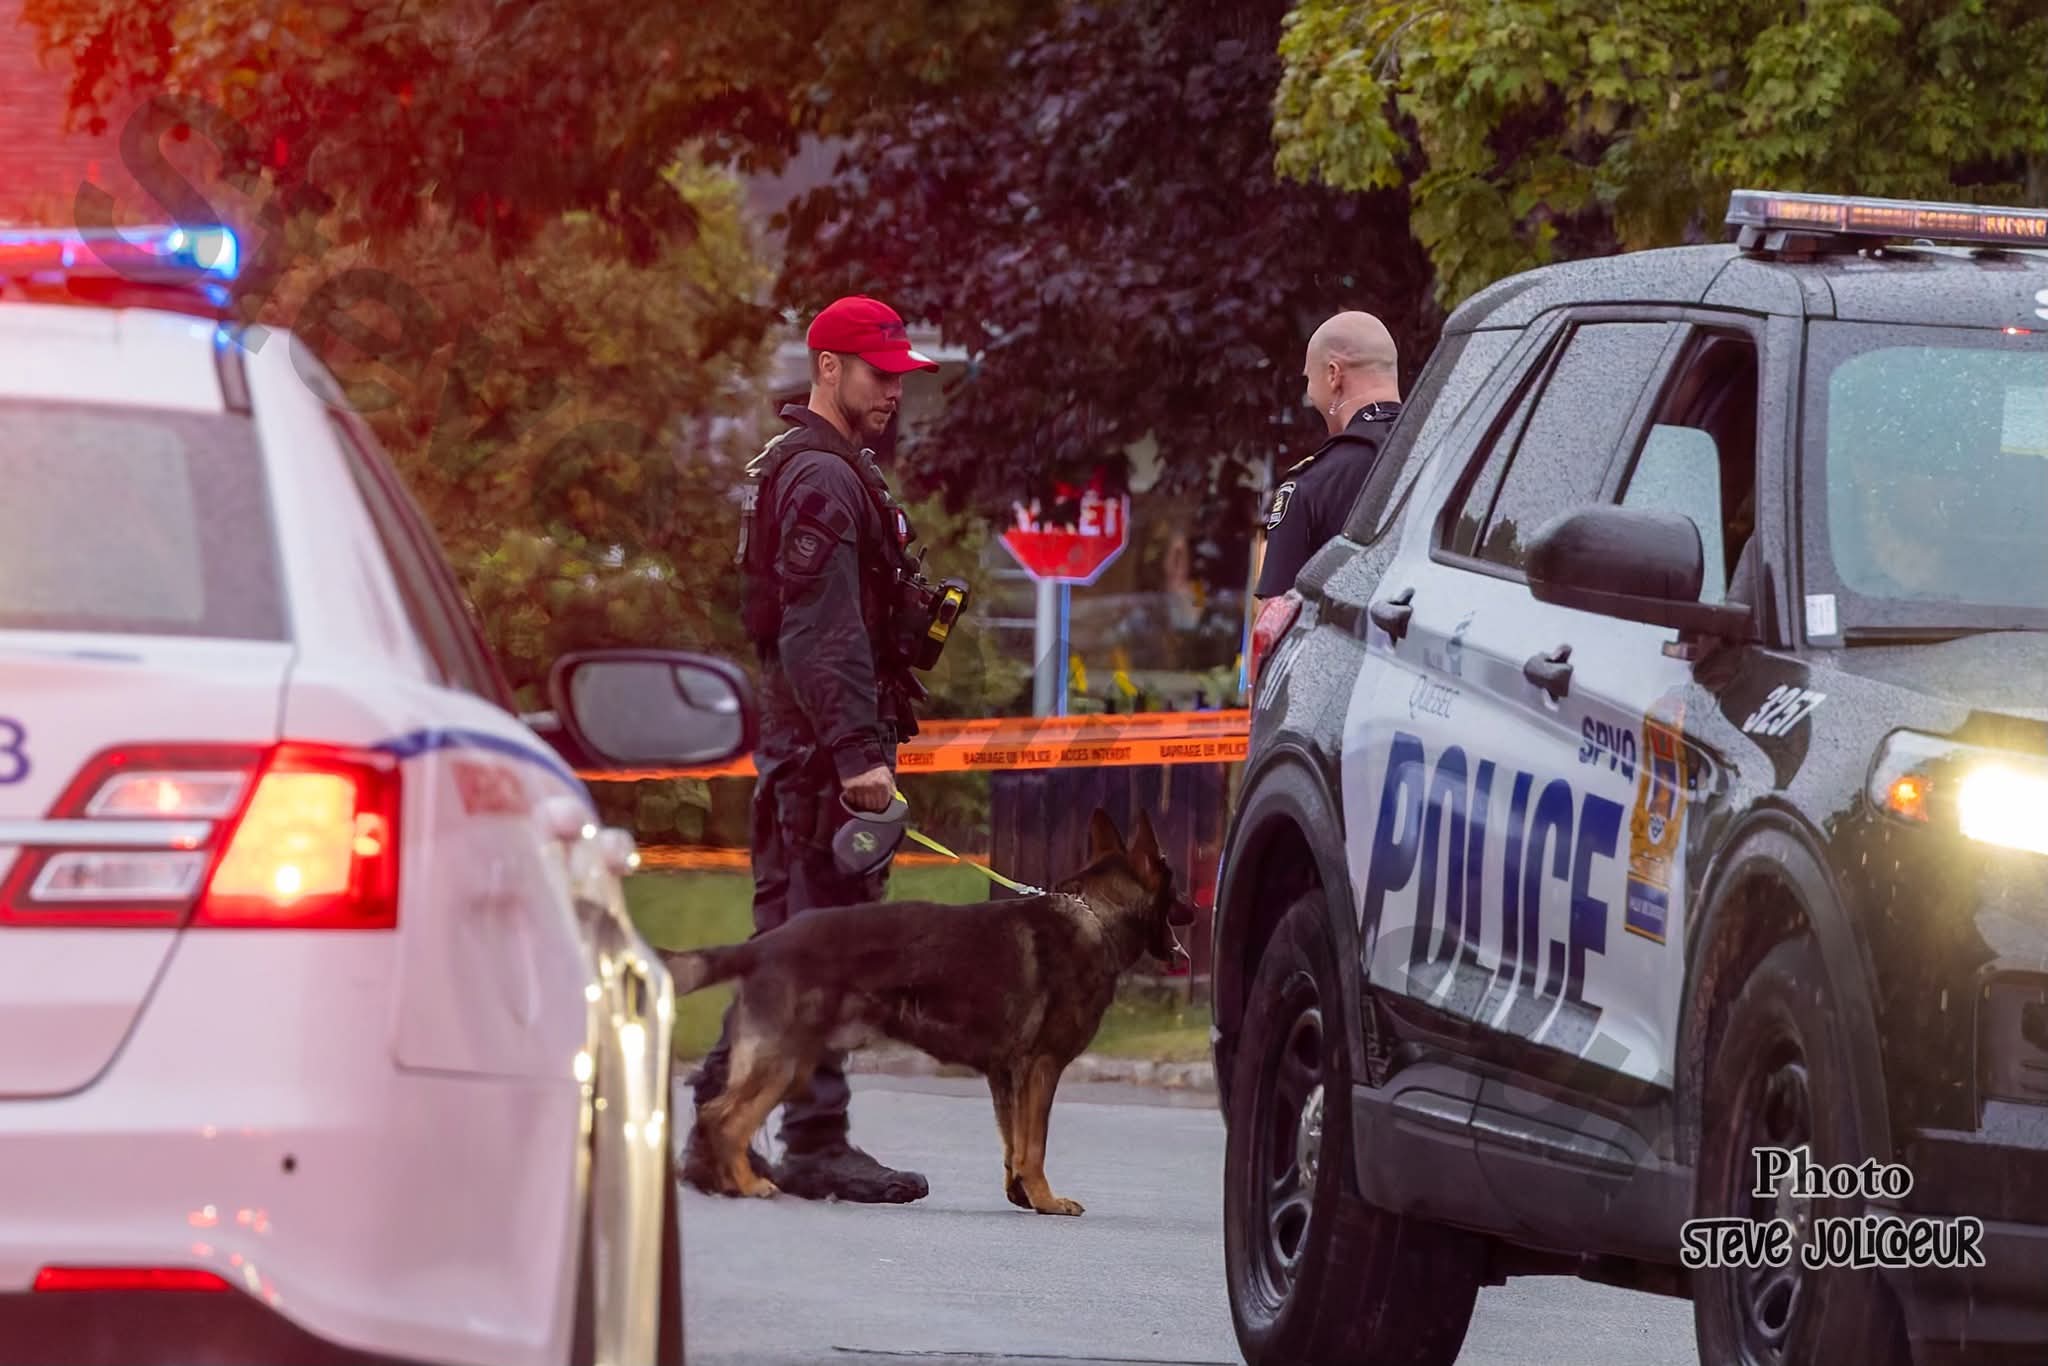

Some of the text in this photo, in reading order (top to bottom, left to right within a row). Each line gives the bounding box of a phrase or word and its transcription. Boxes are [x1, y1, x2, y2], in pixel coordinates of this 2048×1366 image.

[1743, 684, 1828, 738] 3257
[1020, 749, 1051, 763] POLICE
[1579, 716, 1637, 785] SPVQ
[1360, 730, 1625, 1058] POLICE
